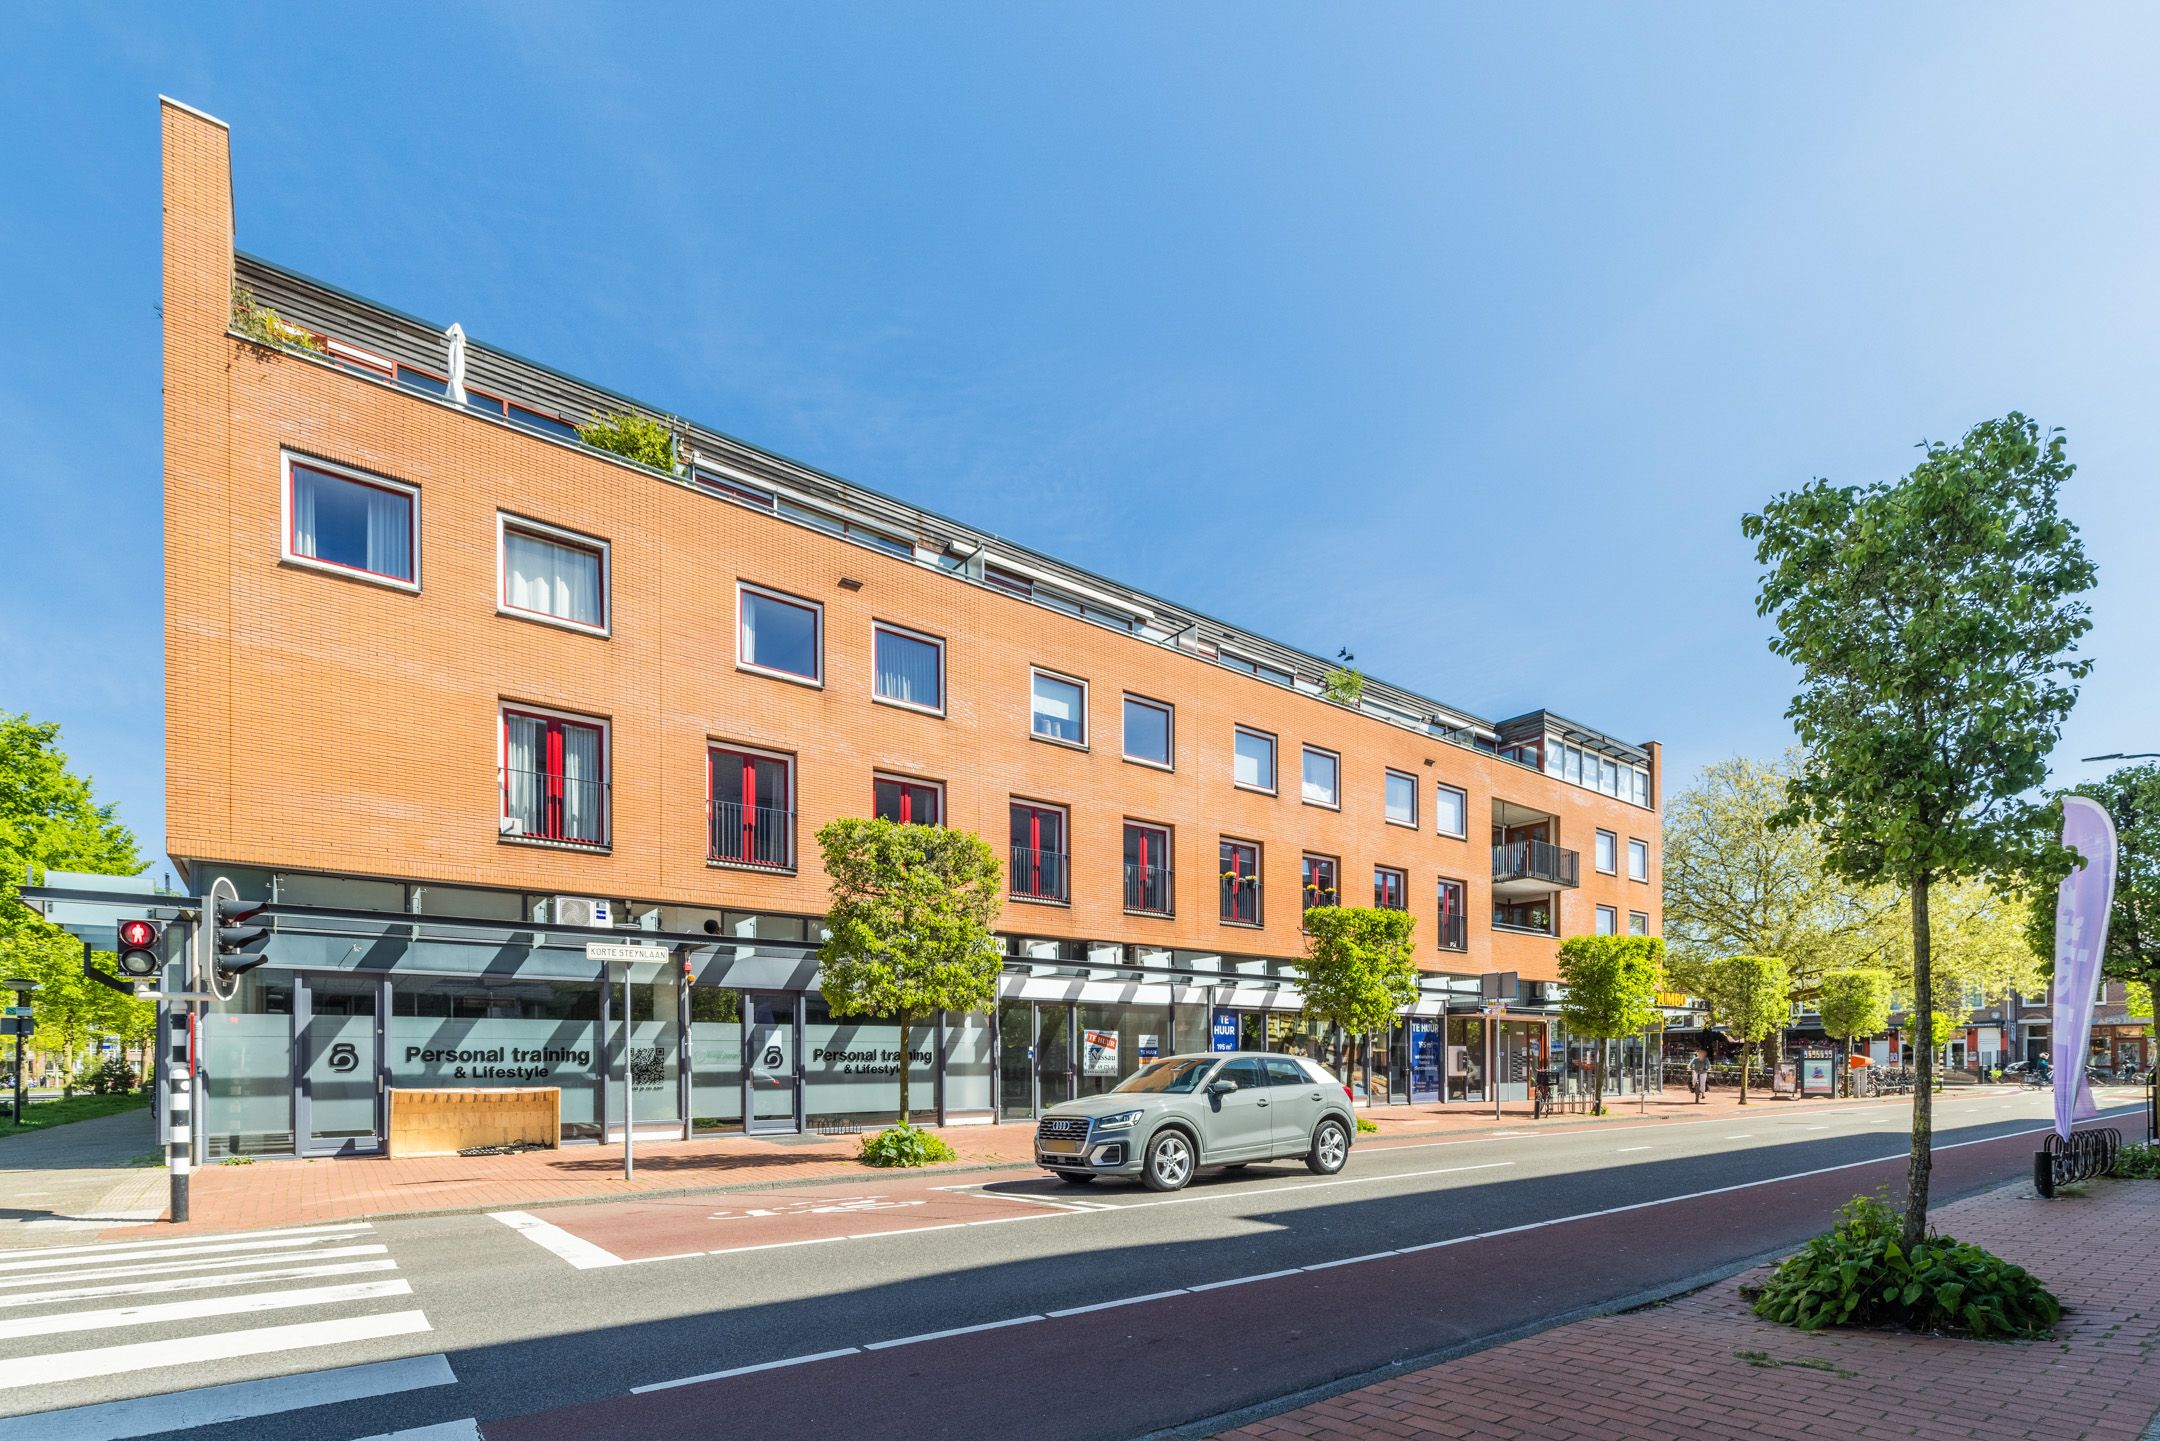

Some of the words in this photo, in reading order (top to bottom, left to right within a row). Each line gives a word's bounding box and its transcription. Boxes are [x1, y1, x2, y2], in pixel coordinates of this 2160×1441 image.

[590, 947, 617, 957] KORTE
[619, 948, 666, 959] STEYNLAAN
[1220, 1014, 1230, 1025] TE
[1214, 1025, 1235, 1036] HUUR
[1412, 1023, 1420, 1032] TE
[1421, 1023, 1439, 1033] HUUR
[1088, 1033, 1097, 1041] TE
[405, 1046, 504, 1063] Personal
[512, 1047, 590, 1066] training
[812, 1048, 877, 1062] Personal
[881, 1048, 933, 1065] traning
[453, 1065, 466, 1079] &
[473, 1065, 549, 1081] Lifestyle
[843, 1064, 851, 1074] &
